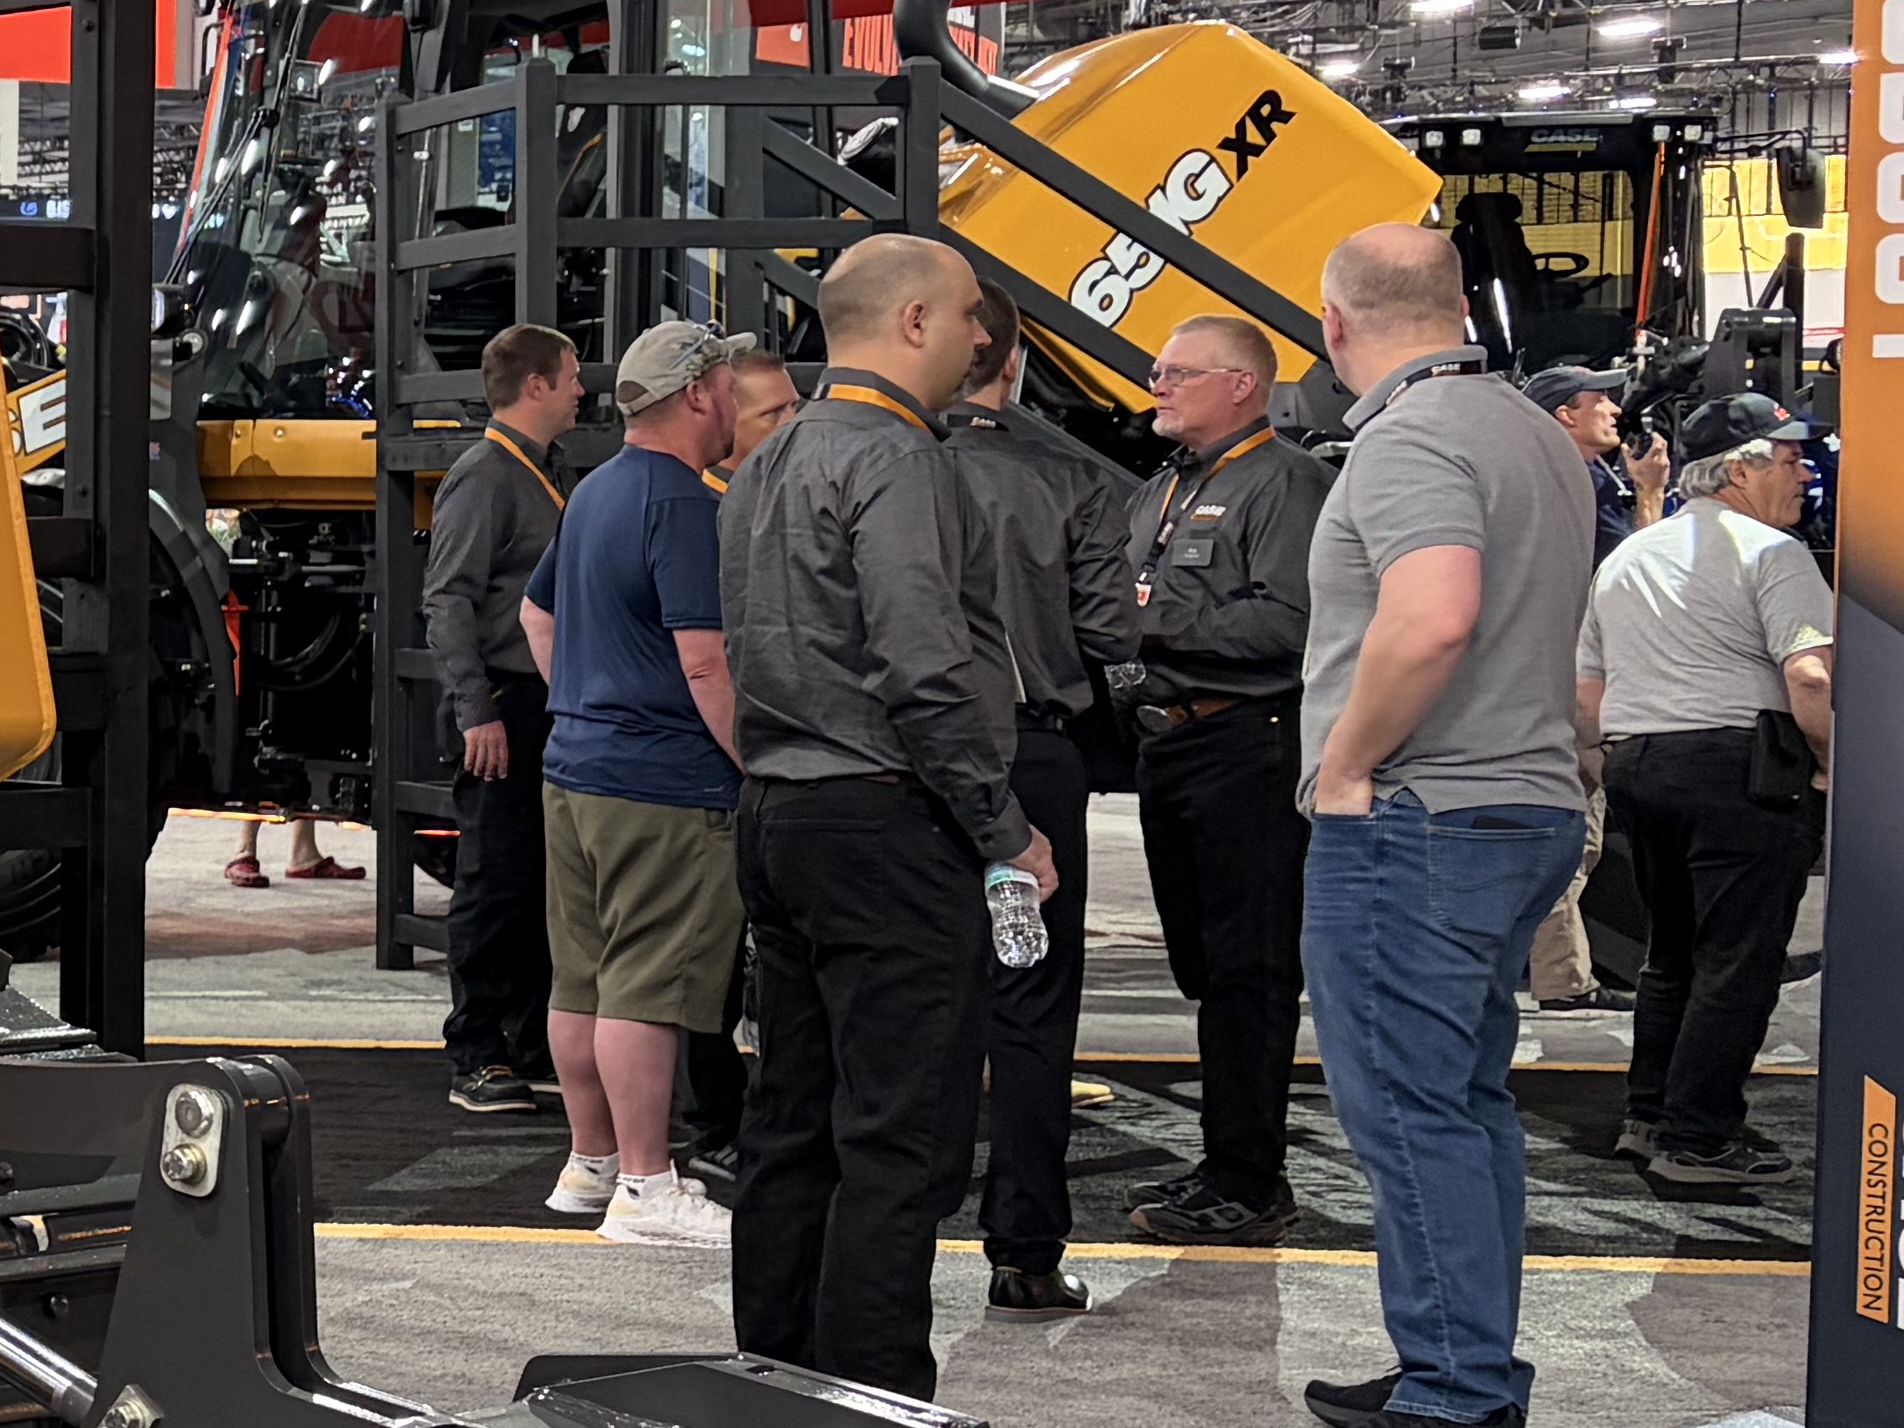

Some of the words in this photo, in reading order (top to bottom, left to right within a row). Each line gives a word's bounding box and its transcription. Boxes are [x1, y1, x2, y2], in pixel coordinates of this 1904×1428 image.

[1216, 89, 1297, 182] XR
[1530, 128, 1600, 143] CASE
[1862, 1122, 1890, 1312] CONSTRUCTION
